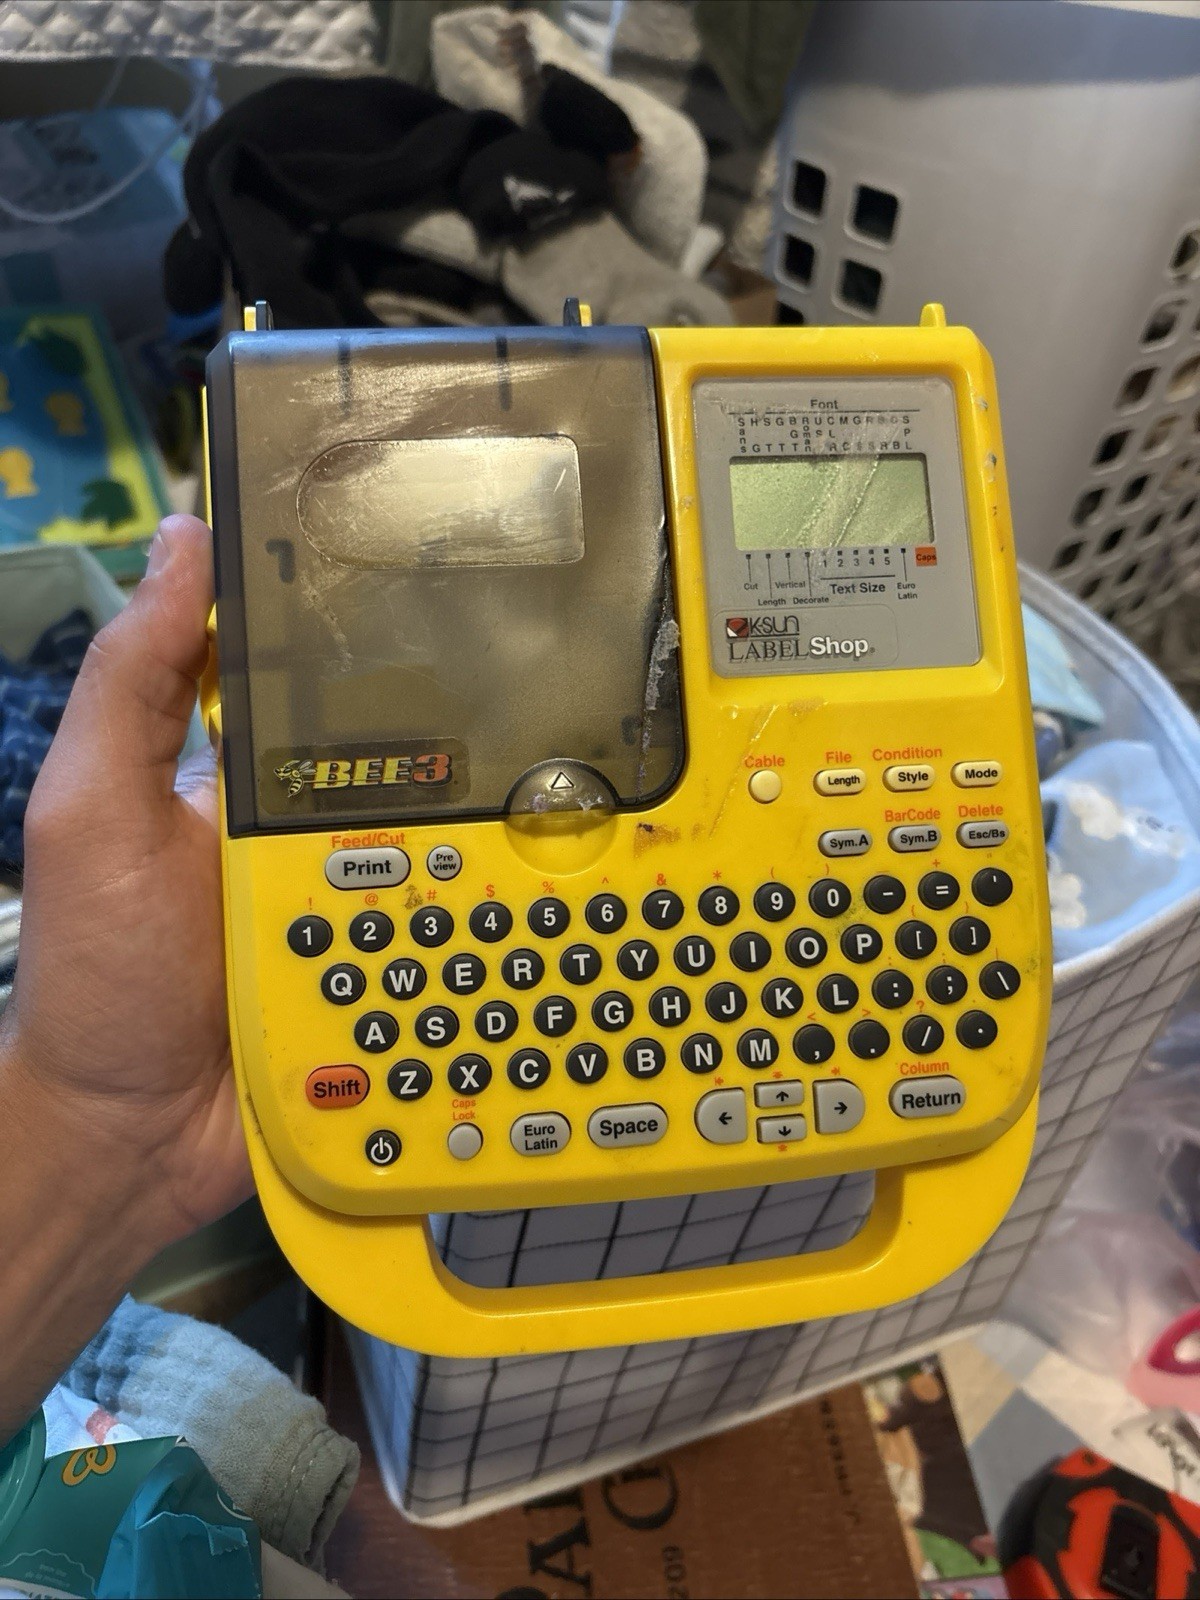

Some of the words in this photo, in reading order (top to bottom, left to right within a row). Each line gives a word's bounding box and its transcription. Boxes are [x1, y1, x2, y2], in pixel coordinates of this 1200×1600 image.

[810, 400, 838, 410] Font
[837, 558, 844, 568] 2
[853, 557, 860, 567] 3
[868, 557, 876, 566] 4
[884, 556, 890, 566] 5
[916, 553, 937, 563] Caps
[744, 582, 758, 591] Cut
[774, 580, 806, 590] Vertical
[830, 583, 856, 595] Text
[859, 582, 886, 594] Size
[897, 582, 916, 591] Euro
[758, 597, 786, 607] Length
[793, 595, 829, 605] Decorate
[897, 592, 918, 601] Latin
[825, 751, 852, 764] File
[872, 747, 942, 761] Condition
[744, 755, 785, 769] Cable
[312, 753, 453, 791] BEE3
[898, 772, 928, 784] Style
[965, 768, 998, 779] Mode
[828, 775, 860, 787] Length
[884, 808, 940, 823] BarCode
[958, 804, 1003, 818] Delete
[331, 832, 405, 848] Feed/Cut
[900, 830, 938, 845] Sym.B
[968, 829, 1006, 840] Esc/Bs
[829, 835, 869, 849] Sym.A
[435, 853, 454, 863] Pre
[343, 859, 392, 877] Print
[433, 861, 457, 872] view
[364, 892, 379, 906] @
[426, 889, 438, 901] #
[485, 884, 495, 899] $
[542, 881, 554, 893] %
[656, 873, 666, 886] &
[303, 927, 311, 945] 1
[364, 922, 376, 940] 2
[425, 917, 437, 935] 3
[485, 912, 497, 930] 4
[544, 908, 556, 926] 5
[602, 904, 614, 922] 6
[658, 900, 670, 918] 7
[716, 896, 728, 914] 8
[771, 892, 783, 910] 9
[827, 889, 839, 907] 0
[330, 973, 353, 996] Q
[389, 969, 417, 992] W
[455, 963, 473, 986] E
[514, 959, 533, 981] R
[573, 954, 590, 976] T
[630, 949, 648, 971] Y
[687, 945, 706, 967] U
[750, 941, 756, 963] I
[799, 937, 819, 959] O
[857, 934, 873, 955] P
[916, 1000, 925, 1012] ?
[365, 1022, 386, 1045] A
[427, 1017, 446, 1040] S
[487, 1012, 506, 1035] D
[547, 1006, 563, 1028] F
[604, 1001, 624, 1024] G
[662, 996, 681, 1019] H
[722, 992, 736, 1014] J
[775, 988, 795, 1010] K
[833, 984, 849, 1005] L
[400, 1071, 418, 1094] Z
[460, 1065, 479, 1089] X
[519, 1059, 539, 1082] C
[578, 1054, 597, 1076] V
[637, 1049, 655, 1072] B
[694, 1043, 713, 1066] N
[750, 1039, 772, 1062] M
[900, 1061, 950, 1076] Column
[313, 1079, 361, 1098] Shift
[452, 1099, 476, 1109] Caps
[902, 1091, 961, 1110] Return
[452, 1111, 476, 1121] Lock
[524, 1124, 556, 1137] Euro
[600, 1119, 659, 1139] Space
[524, 1138, 558, 1151] Latin
